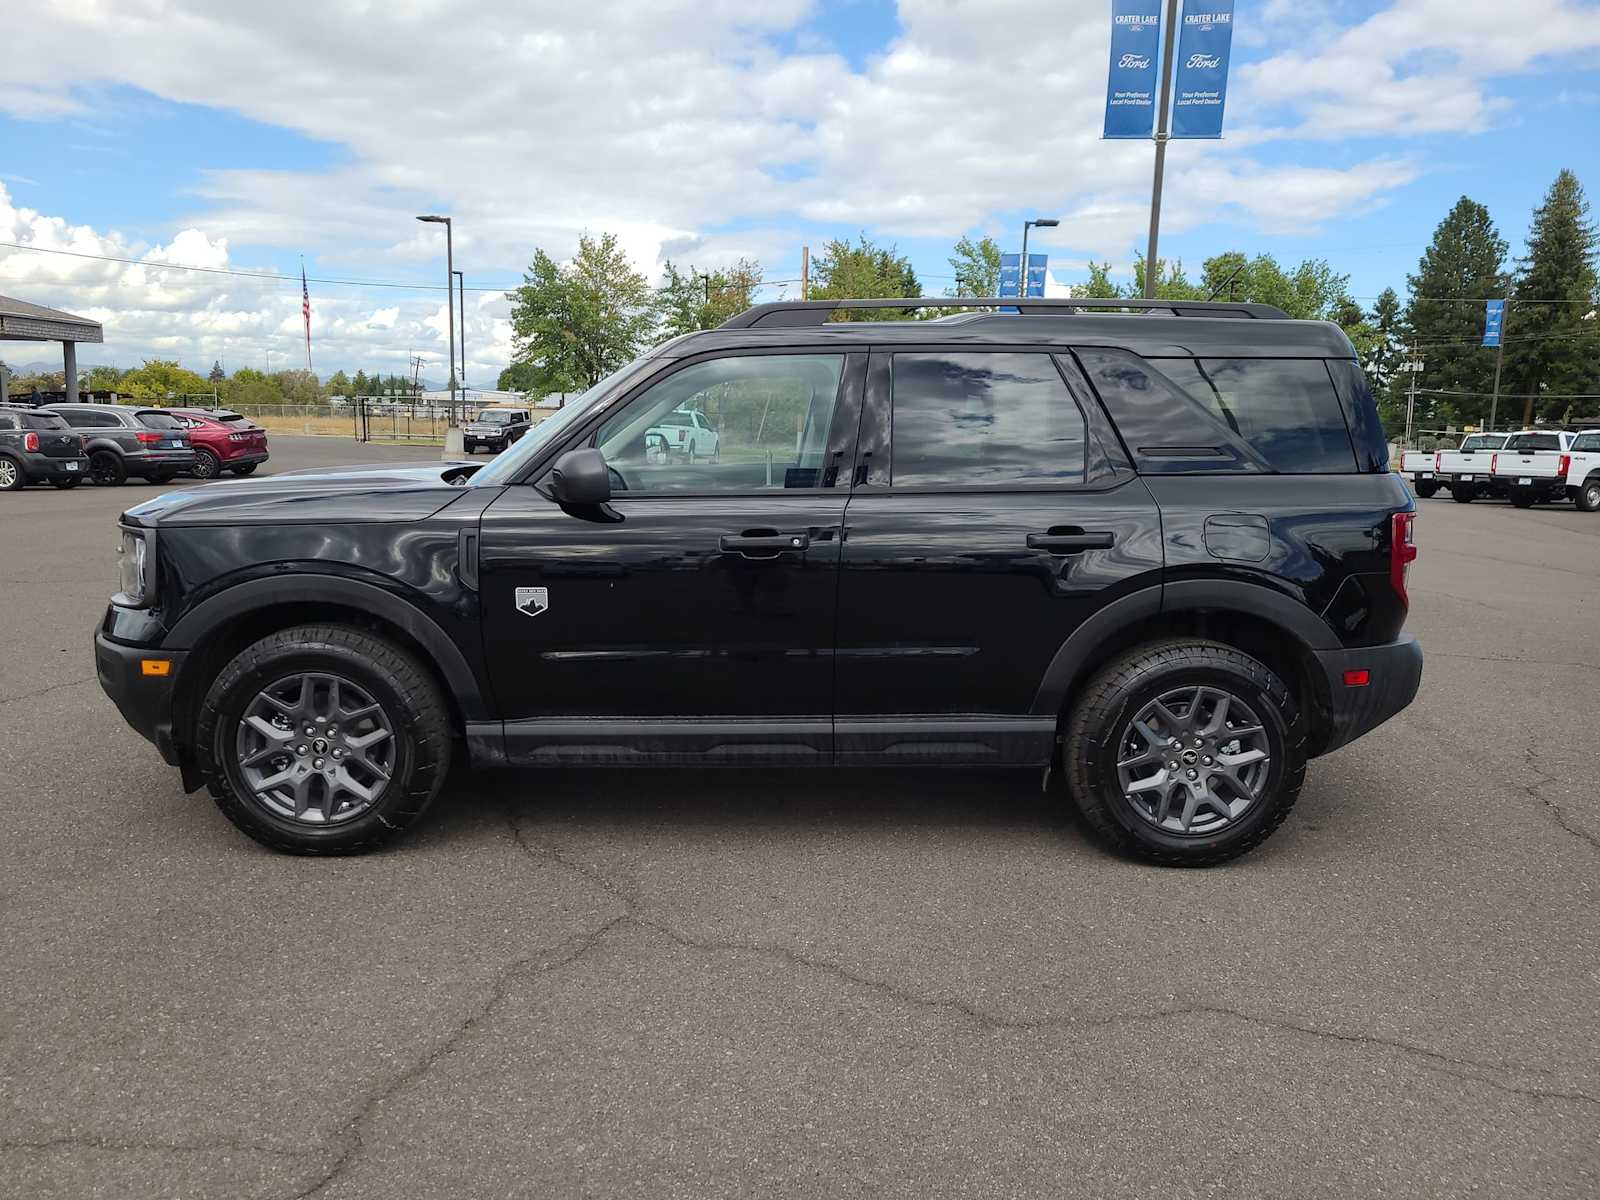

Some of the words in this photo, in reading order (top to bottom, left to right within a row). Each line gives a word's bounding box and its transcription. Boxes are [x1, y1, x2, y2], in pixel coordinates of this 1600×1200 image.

[1115, 15, 1140, 24] CRATER
[1141, 15, 1158, 24] LAKE
[1185, 15, 1211, 24] CRATER
[1212, 14, 1231, 23] LAKE
[1118, 53, 1151, 69] Ford
[1186, 53, 1221, 69] Ford
